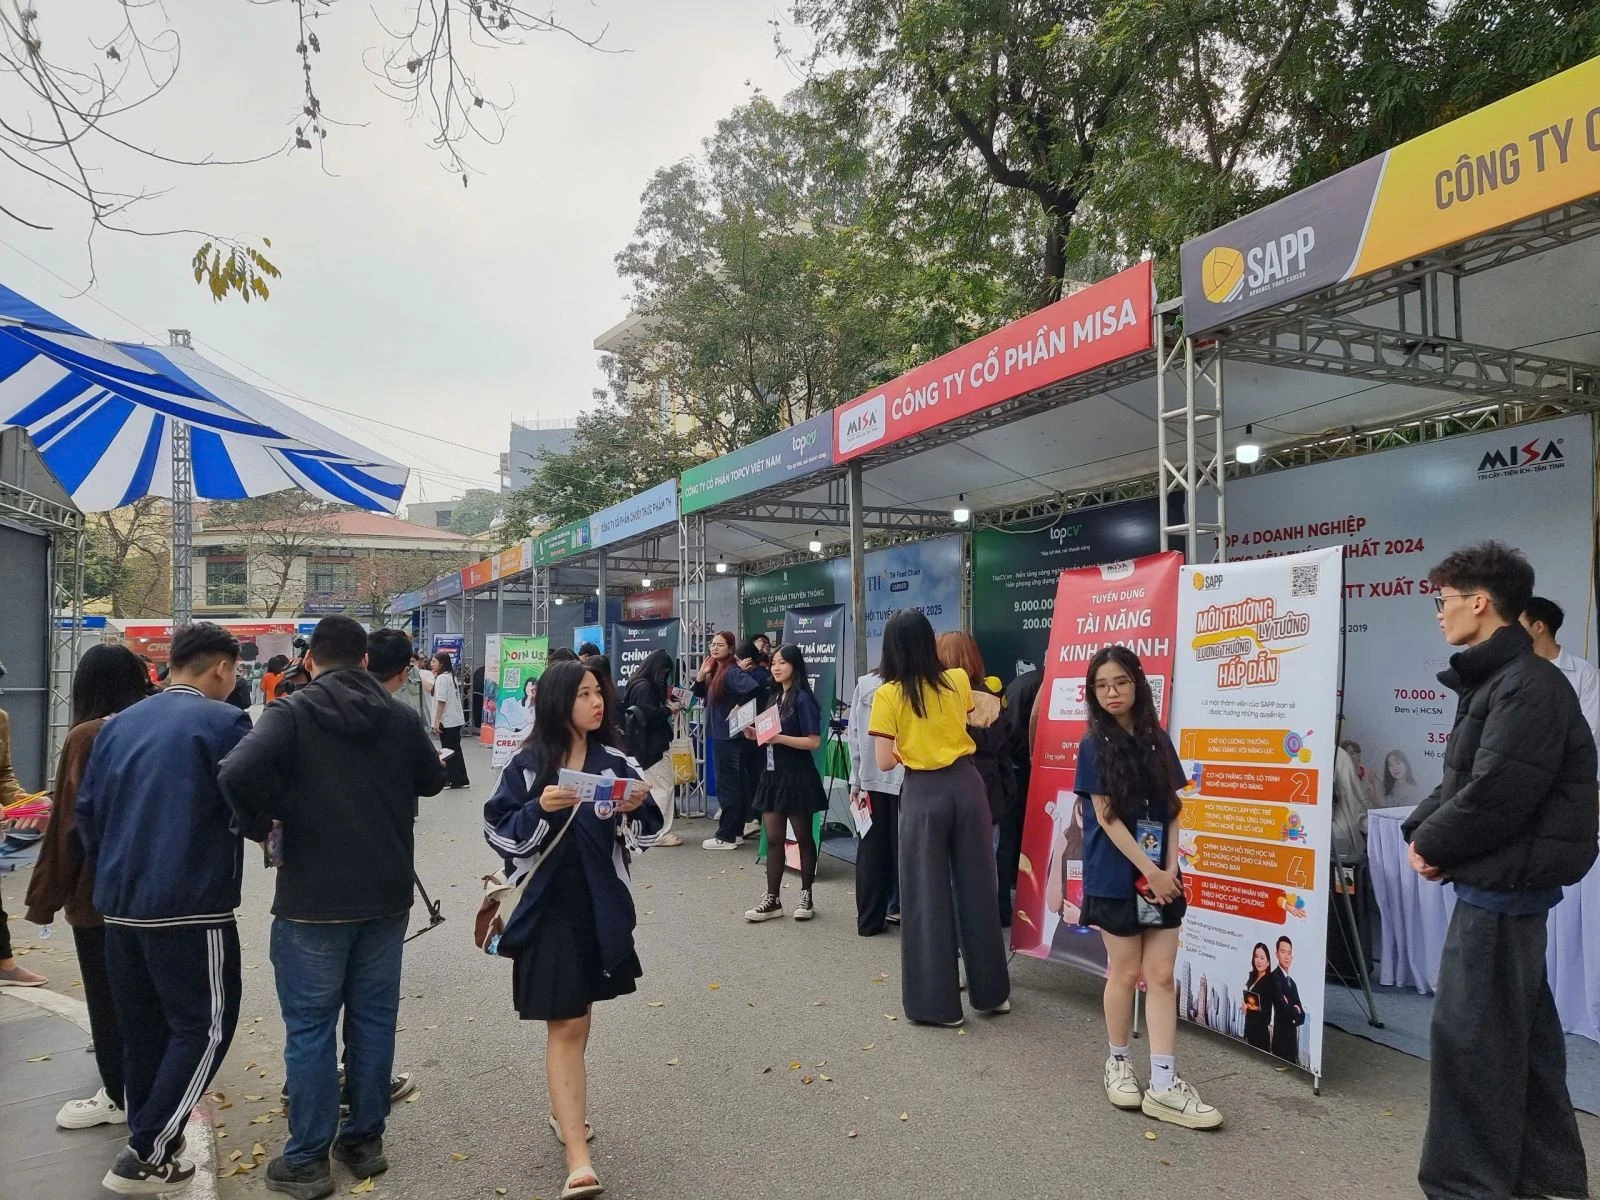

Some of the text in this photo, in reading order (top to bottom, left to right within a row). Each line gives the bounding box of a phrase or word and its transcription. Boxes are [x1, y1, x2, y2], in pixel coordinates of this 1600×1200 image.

[1435, 142, 1520, 210] CÔNG
[1528, 117, 1574, 173] TY
[1247, 226, 1315, 288] SAPP
[891, 298, 1137, 420] CÔNG TY CỔ PHẦN MISA
[847, 410, 877, 436] MISA
[1477, 437, 1564, 471] MISA
[684, 485, 699, 498] CÔNG
[699, 483, 707, 493] TY
[714, 474, 730, 487] PHẦN
[730, 467, 750, 481] TOPCV
[750, 460, 765, 476] VIỆT
[765, 453, 781, 469] NAM
[1214, 515, 1366, 549] TOP 4 DOANH NGHIỆP
[1384, 537, 1424, 555] 2024
[867, 576, 880, 591] TH
[1205, 574, 1223, 589] SAPP
[1369, 575, 1414, 597] XUẤT
[1014, 598, 1056, 613] 9.000.00
[1092, 588, 1146, 605] TUYỂN DỤNG
[926, 604, 943, 616] 2025
[1076, 608, 1152, 635] TÀI NĂNG
[1197, 598, 1274, 633] MÔI TRƯỜNG
[1258, 613, 1308, 640] LÝ TƯỞNG
[1348, 624, 1368, 633] 2019
[816, 643, 836, 654] NGAY
[1060, 638, 1169, 663] KINH ANH
[1197, 639, 1249, 658] LƯƠNG THƯỞNG
[1218, 650, 1277, 687] HẤP DẪN
[1393, 689, 1435, 700] 70.000
[1394, 705, 1443, 715] Đơn vị HCSN
[1184, 732, 1197, 760] 1
[1290, 772, 1310, 804] 2
[1180, 801, 1196, 829] 3
[1286, 855, 1307, 888] 4
[1225, 903, 1239, 911] SAPP
